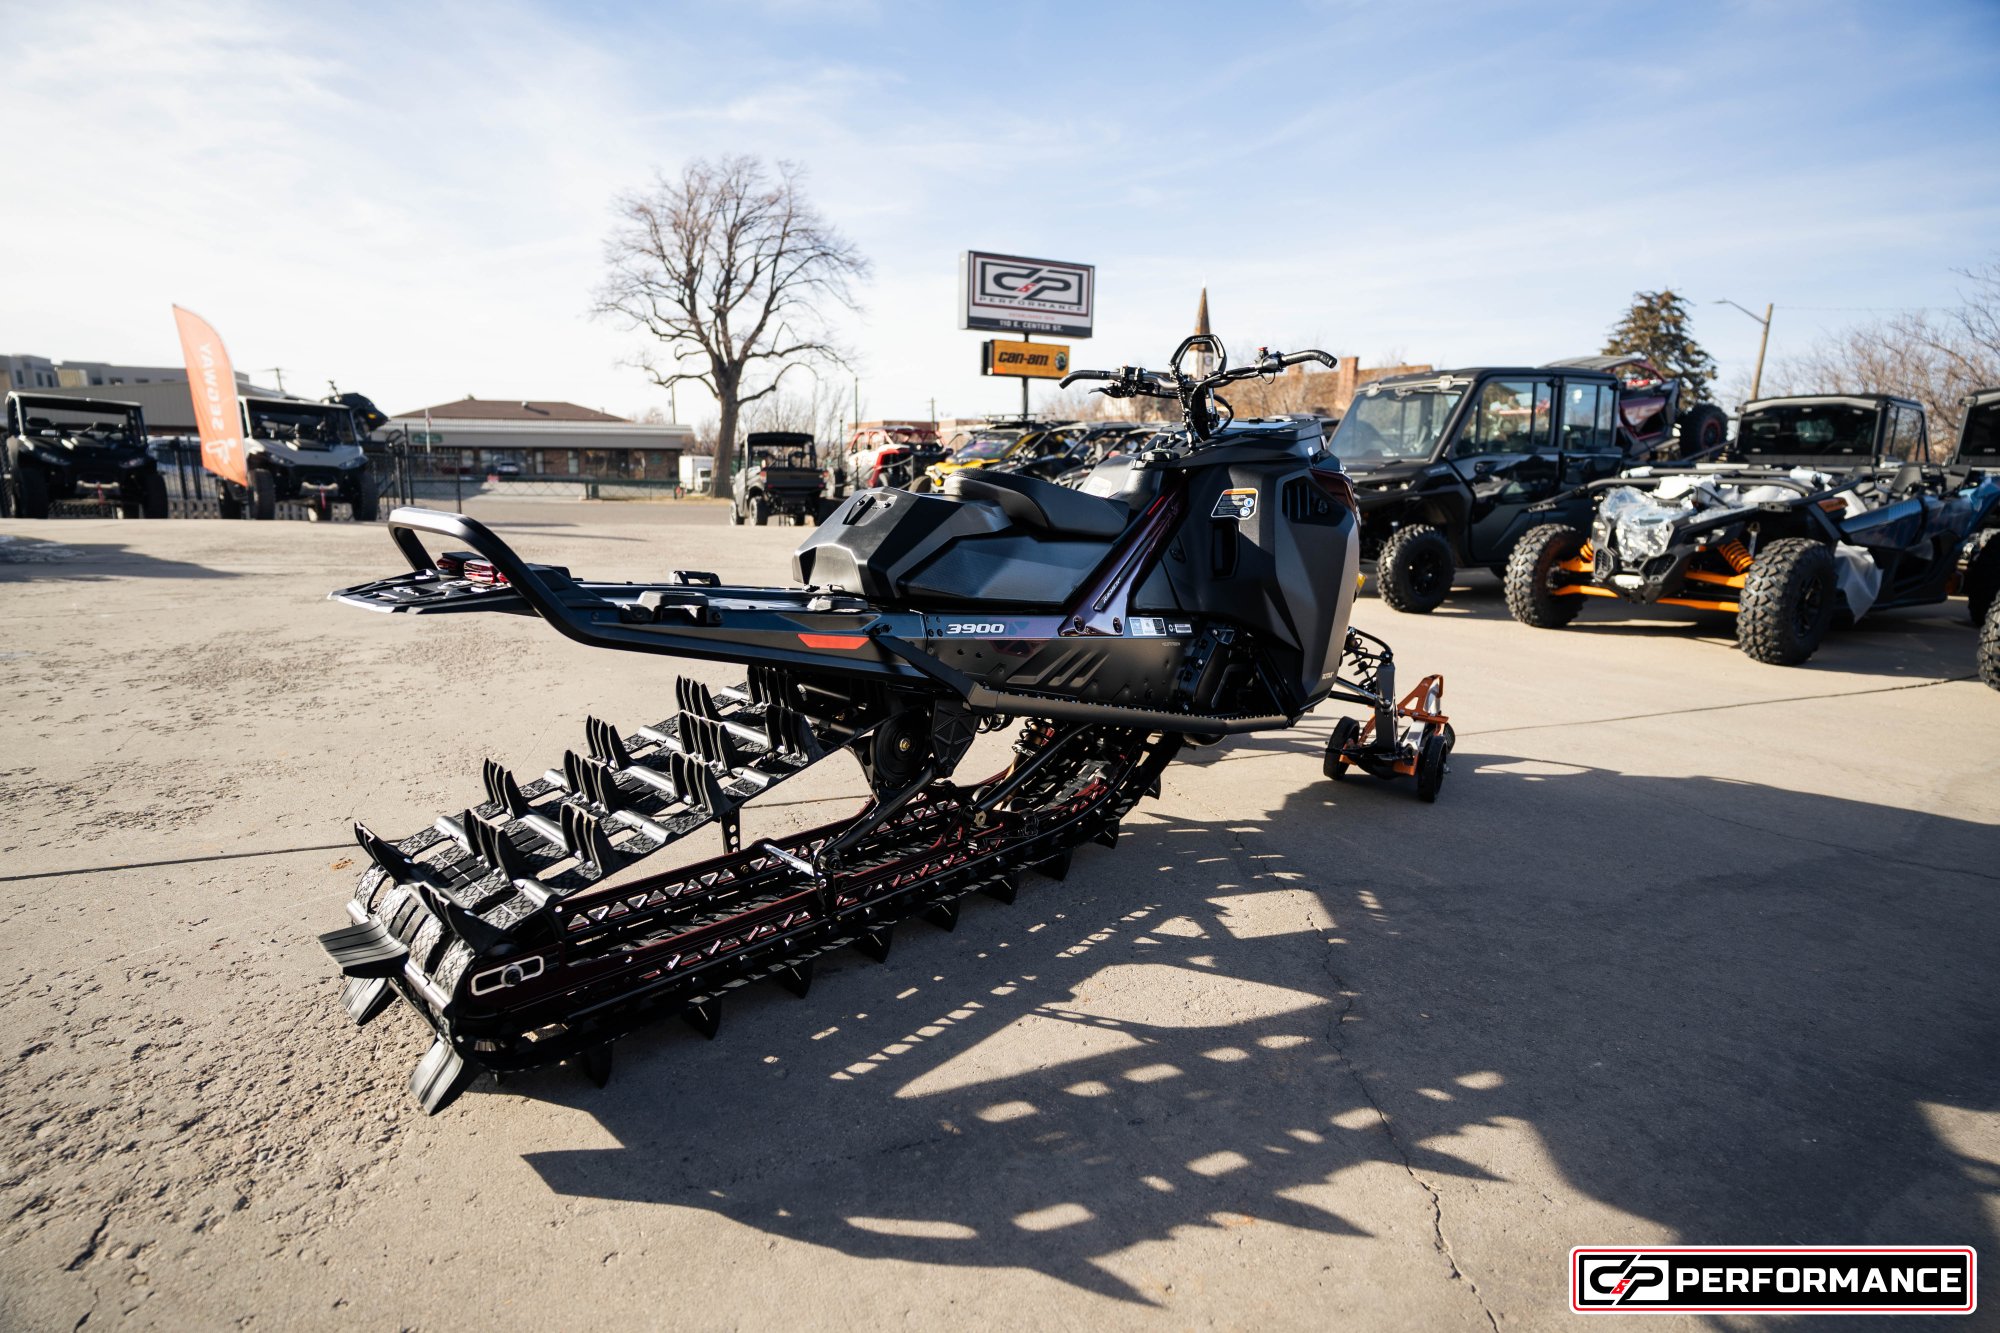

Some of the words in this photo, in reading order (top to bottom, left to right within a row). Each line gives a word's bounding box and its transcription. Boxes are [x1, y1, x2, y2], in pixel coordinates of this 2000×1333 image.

[979, 297, 1083, 311] PERFORMANCE
[999, 320, 1012, 328] 110
[1022, 321, 1051, 331] CENTER
[946, 623, 1005, 634] 3900
